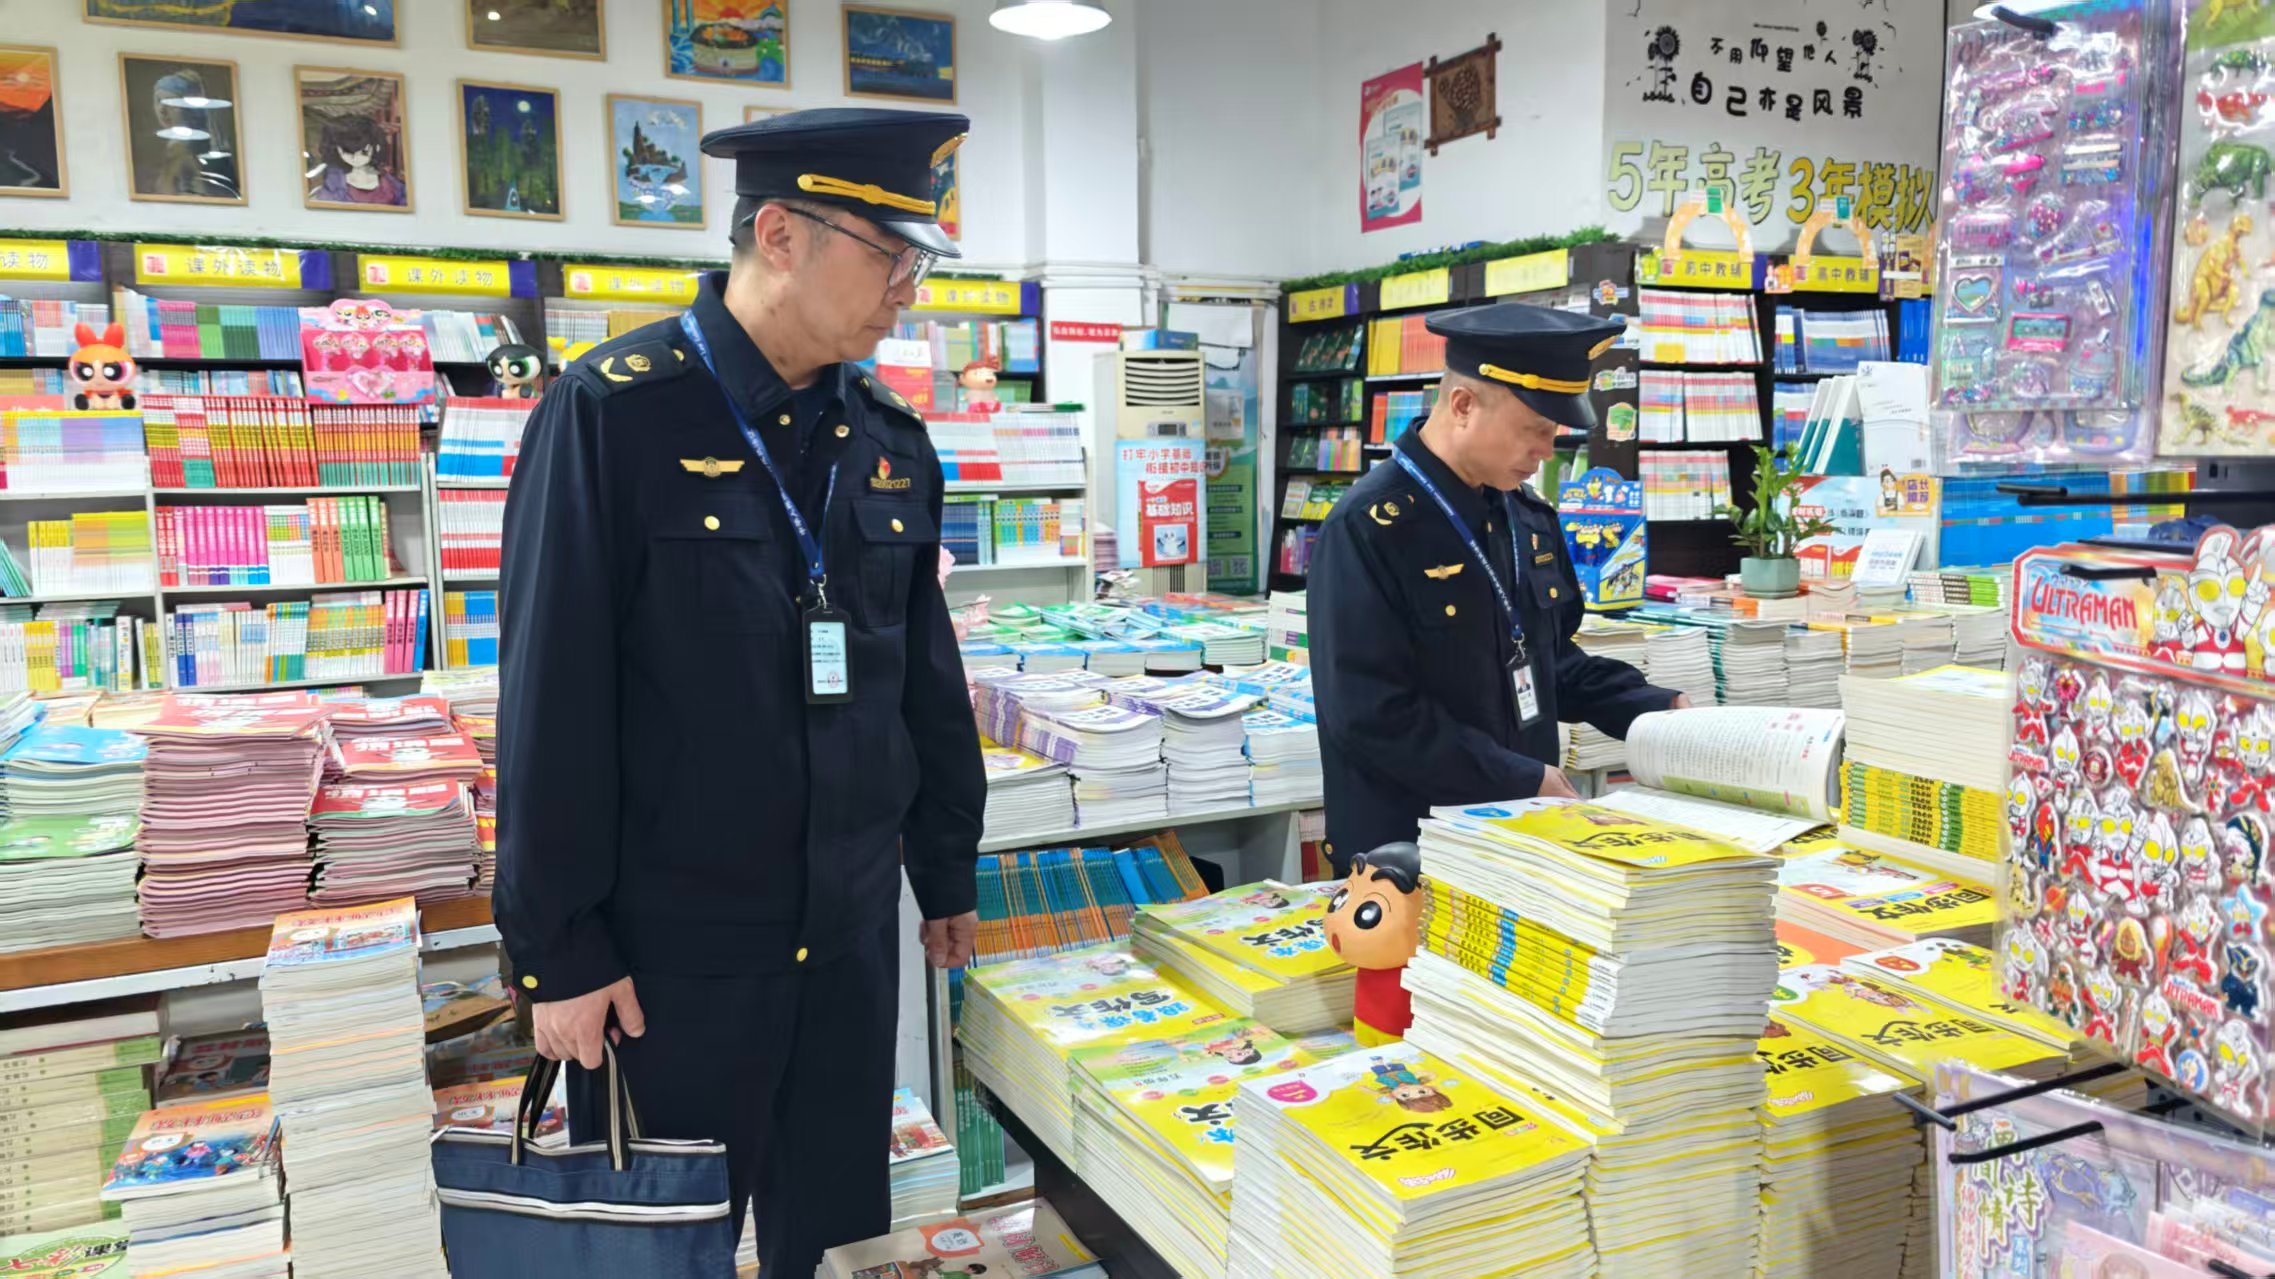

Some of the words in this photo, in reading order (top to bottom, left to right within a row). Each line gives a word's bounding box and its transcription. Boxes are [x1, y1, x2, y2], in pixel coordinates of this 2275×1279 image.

[1710, 37, 1838, 73] 不用仰望他人
[1690, 71, 1864, 121] 自己亦是风景
[1607, 140, 1782, 225] 5年高考
[1785, 156, 1936, 234] 3年模拟
[186, 257, 282, 279] 课外读物
[407, 267, 494, 287] 课外读物
[2031, 575, 2139, 631] ULTRAMAN
[1857, 888, 1992, 921] 同步作文
[1051, 989, 1170, 1021] 写作文
[1860, 1018, 1996, 1047] 同步作文
[1350, 1106, 1525, 1161] 同步作文
